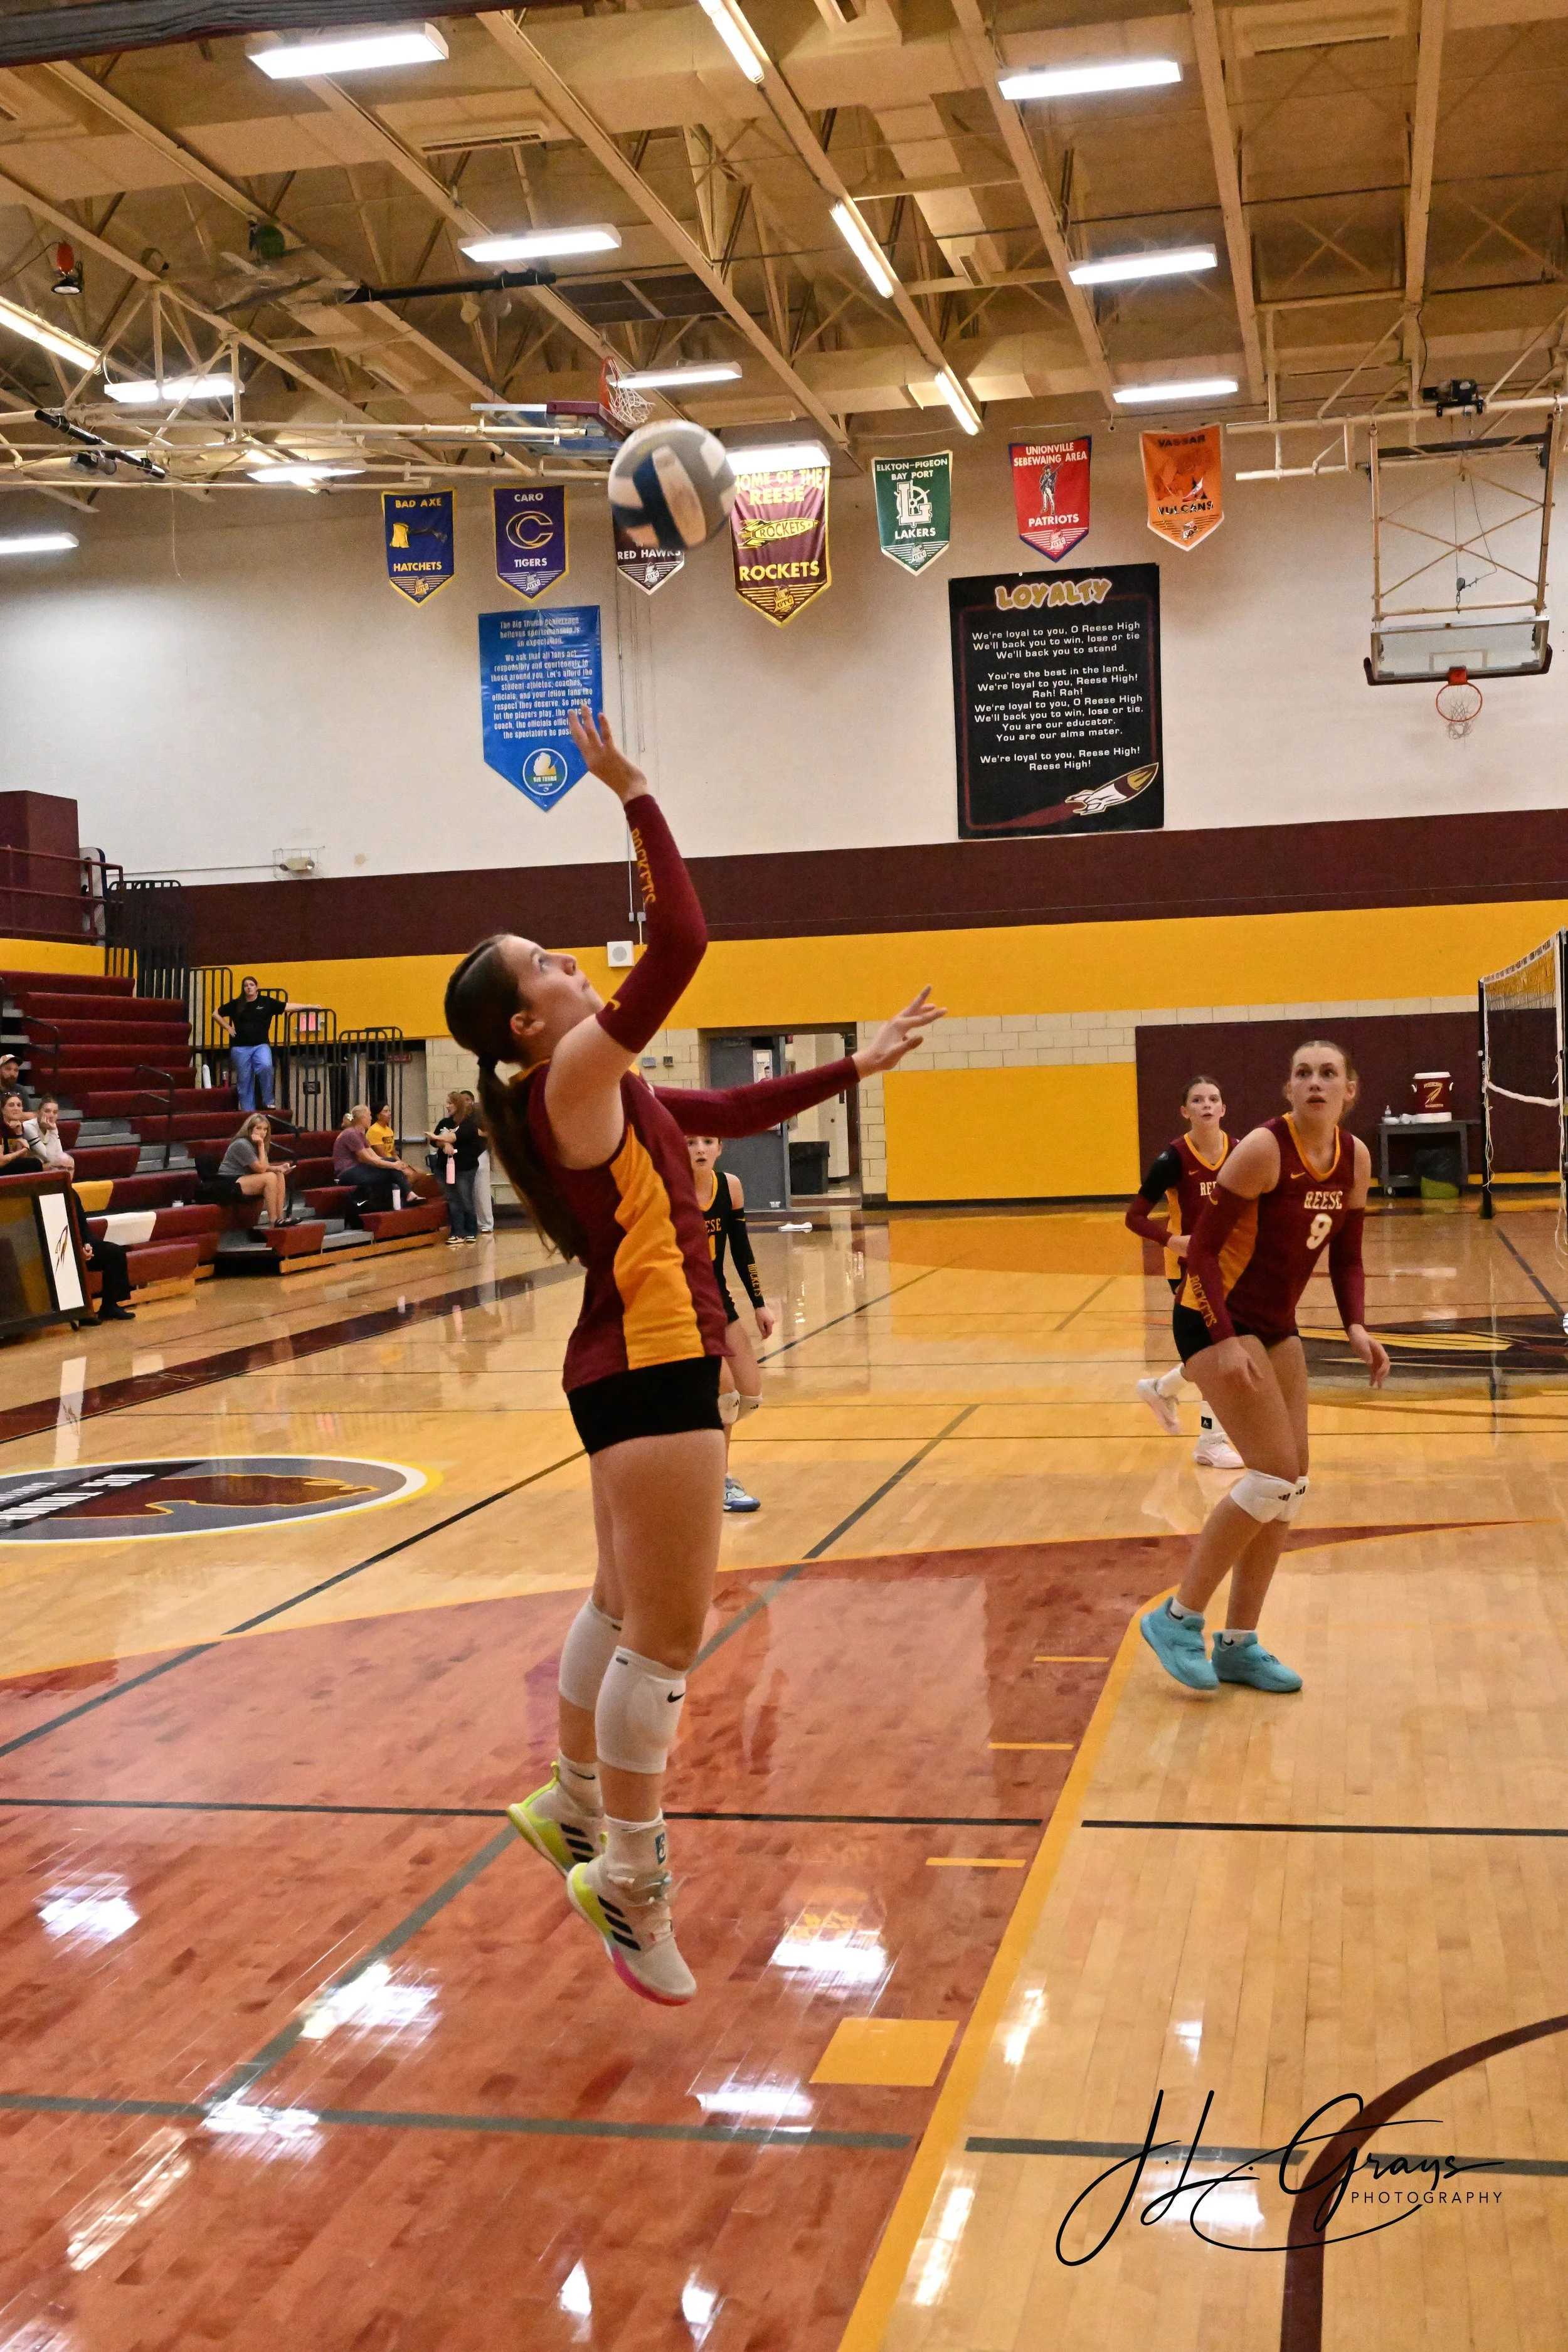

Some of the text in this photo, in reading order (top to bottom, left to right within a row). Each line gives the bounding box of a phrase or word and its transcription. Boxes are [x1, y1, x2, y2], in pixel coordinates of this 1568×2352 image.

[1026, 442, 1074, 456] UNIONVILLE
[877, 458, 948, 471] ELKTON-PIGEON
[1014, 451, 1087, 467] SEBEWAING AREA
[778, 470, 793, 484] OF
[800, 469, 824, 489] THE
[891, 470, 933, 480] BAY PORT
[395, 498, 441, 508] BAD AXE
[514, 493, 543, 502] CARO
[750, 487, 804, 506] REESE
[1157, 501, 1213, 516] VULCANS
[1028, 514, 1079, 527] PATRIOTS
[760, 521, 805, 538] ROCKETS
[895, 527, 936, 540] LAKERS
[617, 549, 636, 559] RED
[393, 561, 442, 572] HATCHETS
[514, 558, 547, 568] TIGERS
[739, 561, 820, 581] ROCKETS
[995, 578, 1112, 610] LOYALTY
[777, 599, 792, 608] GTC
[972, 632, 1002, 640] We're
[1006, 629, 1029, 639] loyal
[1047, 628, 1067, 637] you,
[1082, 624, 1113, 633] Reese
[1117, 621, 1140, 631] High
[973, 642, 999, 650] We'll
[1002, 640, 1025, 649] back
[1029, 640, 1046, 649] you
[996, 650, 1021, 659] We'll
[1025, 649, 1049, 657] back
[1052, 649, 1069, 657] you
[1088, 644, 1116, 652] stand
[988, 672, 1020, 681] You're
[1024, 670, 1041, 678] the
[1044, 669, 1066, 677] best
[1083, 666, 1099, 674] the
[1103, 664, 1127, 673] land.
[978, 683, 1008, 692] We're
[1012, 681, 1034, 691] loyal
[1052, 680, 1073, 688] you,
[1076, 677, 1108, 685] Reese
[1111, 674, 1138, 684] High!
[1032, 687, 1083, 698] Rah! Rah!
[974, 704, 1005, 712] We're
[1009, 701, 1032, 711] loyal
[1049, 701, 1069, 709] you,
[1084, 697, 1115, 706] Reese
[1119, 694, 1142, 704] High
[974, 714, 1000, 723] We'll
[1004, 712, 1027, 721] back
[1030, 712, 1047, 721] you
[1127, 705, 1143, 713] tie.
[1066, 718, 1115, 727] educator.
[996, 734, 1015, 742] You
[1061, 730, 1084, 738] alma
[1089, 728, 1123, 736] mater.
[980, 755, 1010, 763] We're
[1014, 753, 1037, 763] loyal
[1054, 752, 1075, 761] you,
[1079, 750, 1110, 758] Reese
[1113, 746, 1140, 756] High!
[1029, 760, 1091, 771] Reese High!
[1304, 1190, 1343, 1209] REESE
[1306, 1213, 1332, 1249] 9
[1190, 1274, 1217, 1327] ROCKETS
